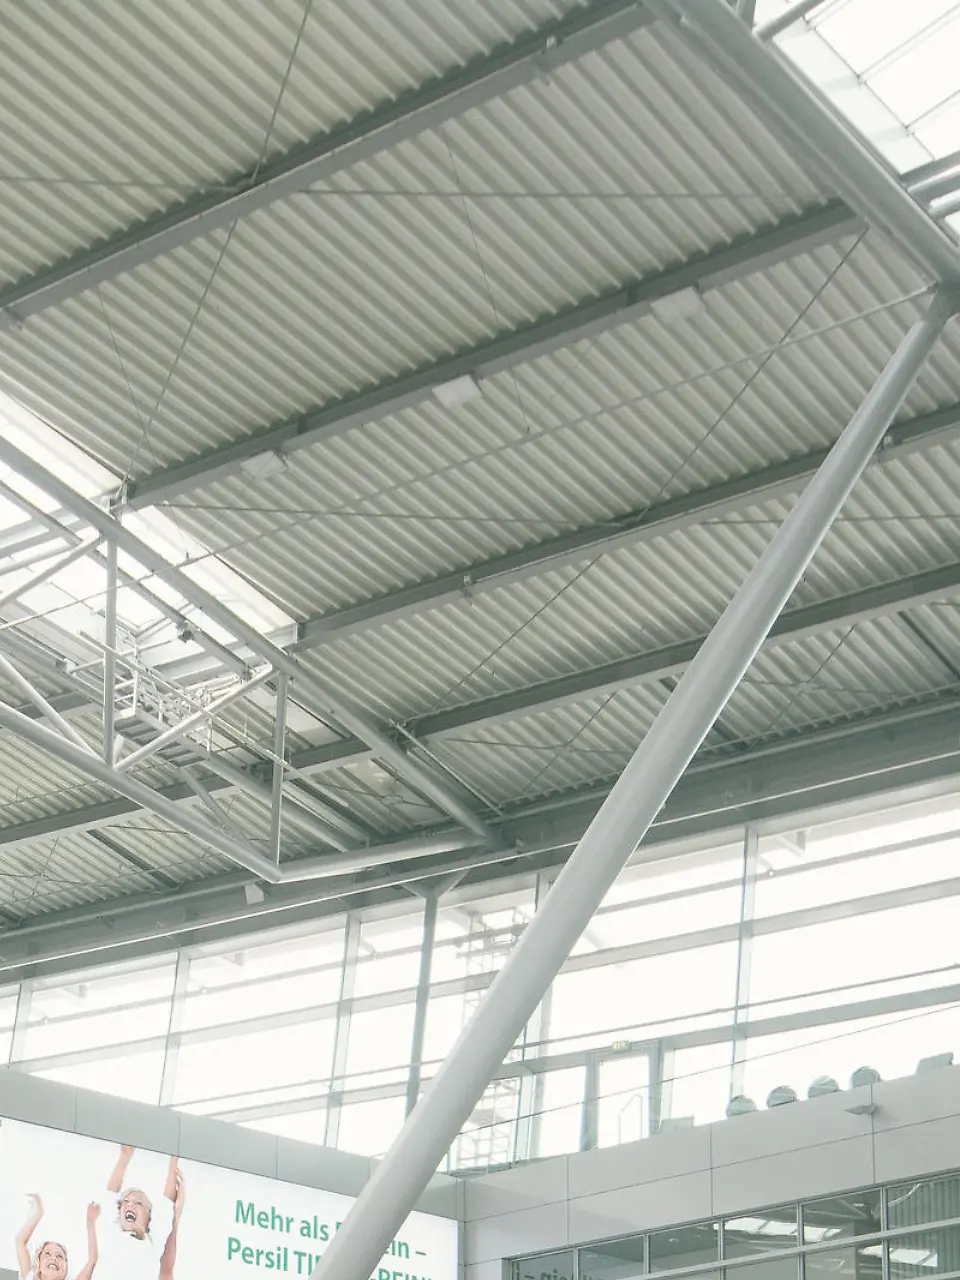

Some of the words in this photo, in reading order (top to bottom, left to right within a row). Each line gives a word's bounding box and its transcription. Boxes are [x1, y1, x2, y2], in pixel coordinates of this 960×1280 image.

[235, 1200, 294, 1233] Mehr
[300, 1216, 329, 1242] als
[227, 1237, 288, 1272] Persil
